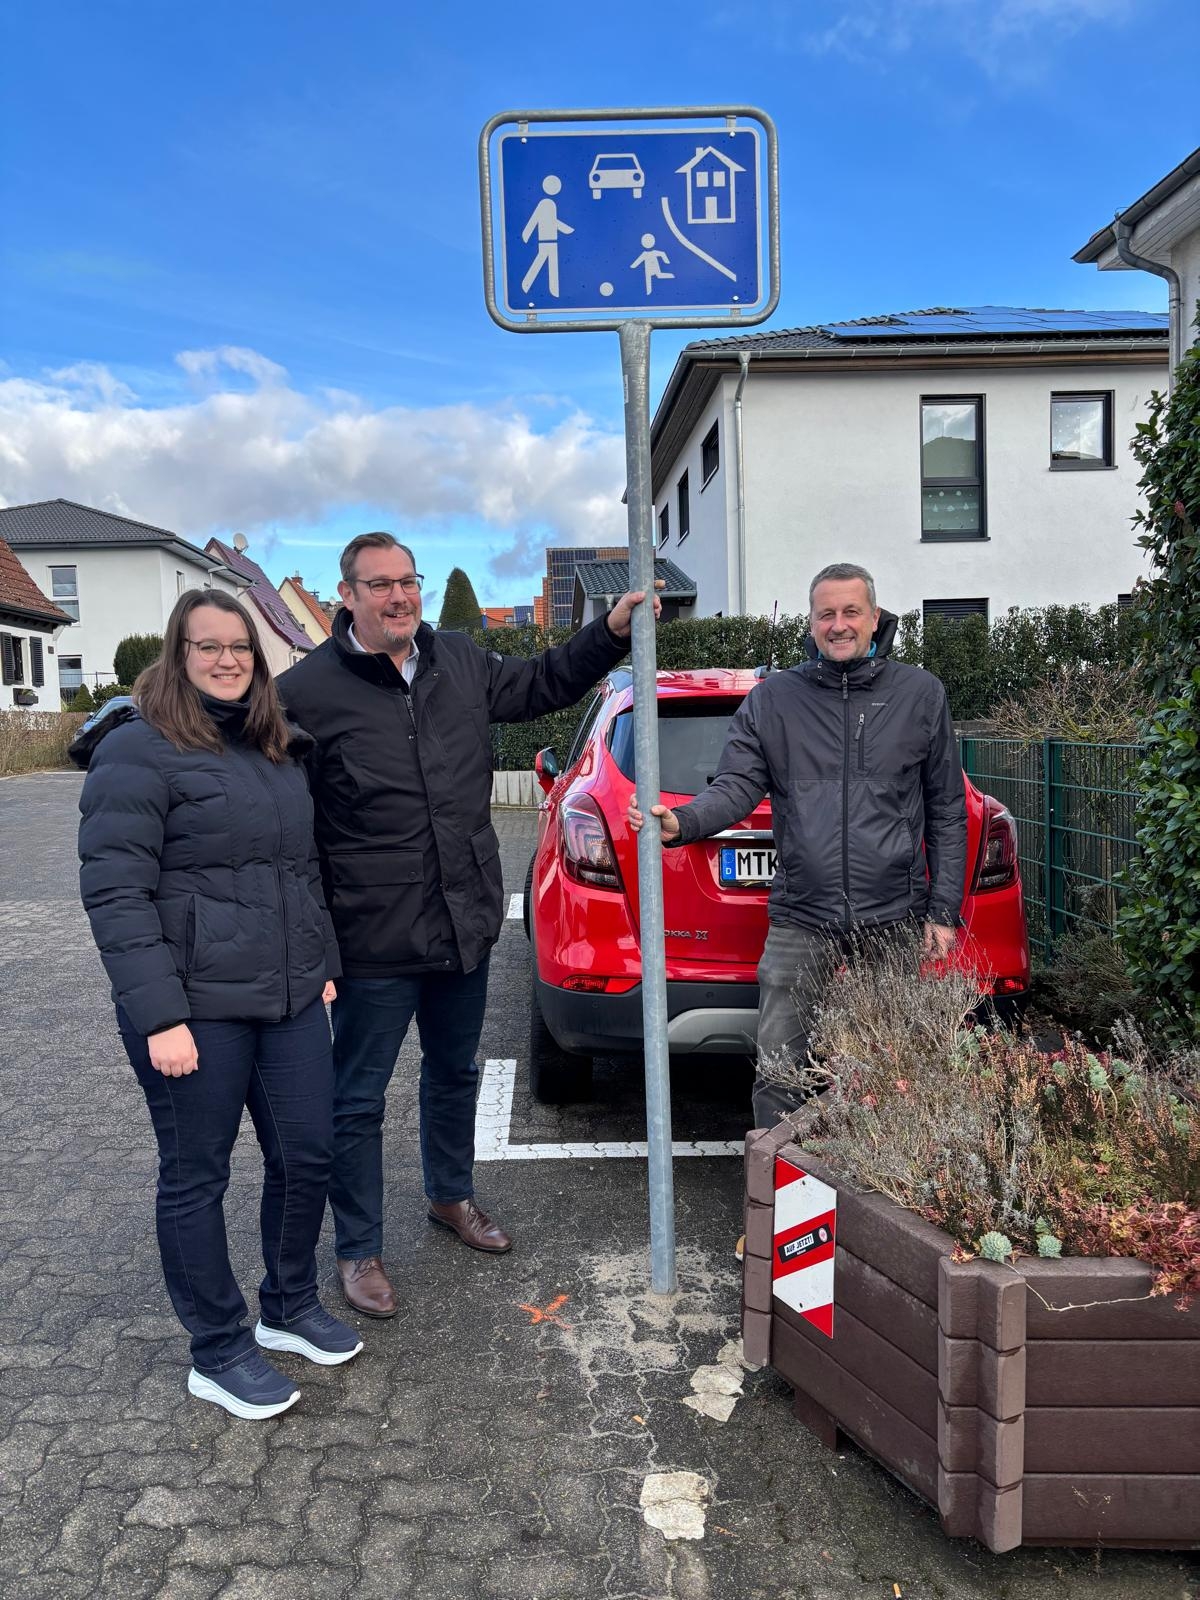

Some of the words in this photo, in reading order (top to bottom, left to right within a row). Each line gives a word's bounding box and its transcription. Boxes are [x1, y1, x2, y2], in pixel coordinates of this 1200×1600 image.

[737, 851, 777, 875] MTK
[663, 929, 691, 938] OKKA
[695, 930, 708, 940] X
[786, 1244, 796, 1254] AUF
[796, 1235, 813, 1248] JETZT!
